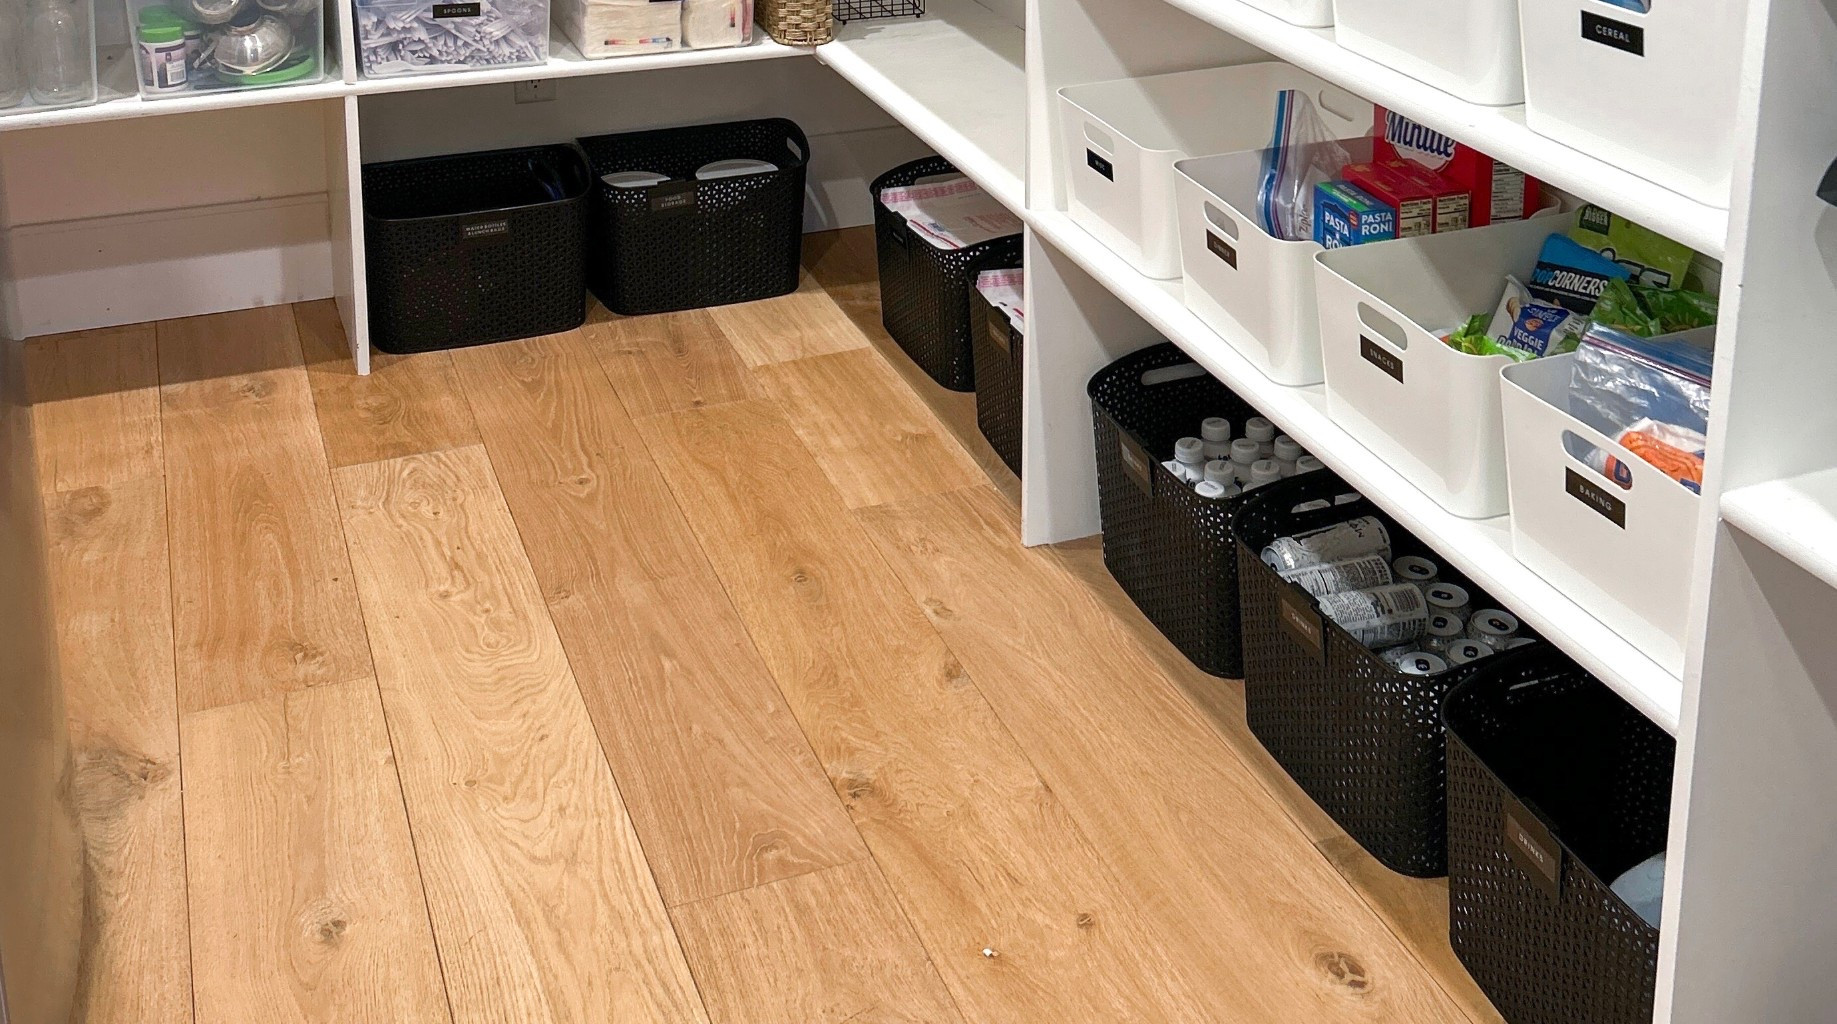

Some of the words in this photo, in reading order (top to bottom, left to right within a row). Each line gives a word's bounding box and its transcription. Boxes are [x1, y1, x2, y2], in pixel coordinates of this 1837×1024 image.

[443, 7, 471, 15] SPOONS
[1595, 24, 1630, 43] CEREAL
[1325, 212, 1350, 237] PASTA
[1361, 212, 1393, 224] PASTA
[1361, 221, 1393, 236] RONI
[1513, 328, 1545, 349] VEGGIE
[1370, 348, 1394, 370] SNACKS
[1579, 484, 1613, 511] BAKING
[1518, 833, 1544, 864] DRINKS
